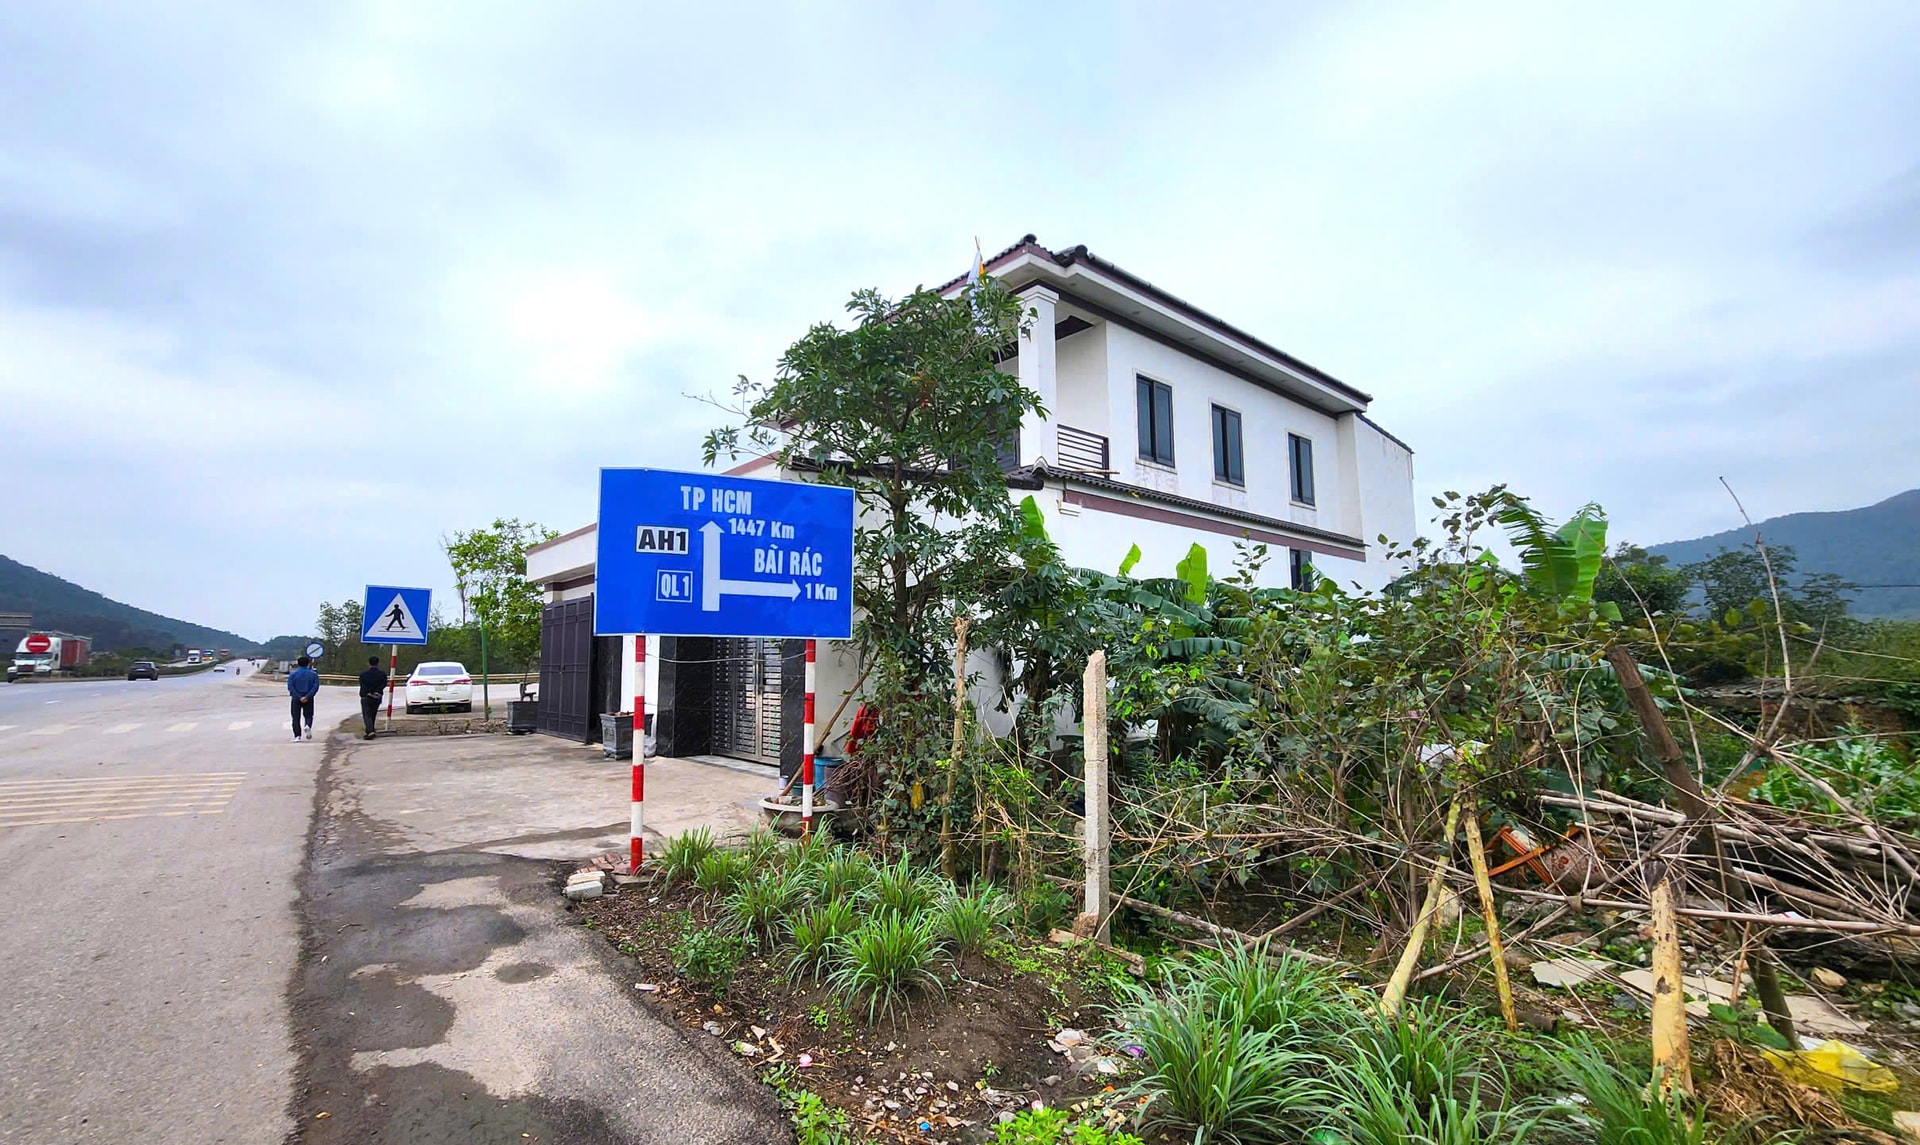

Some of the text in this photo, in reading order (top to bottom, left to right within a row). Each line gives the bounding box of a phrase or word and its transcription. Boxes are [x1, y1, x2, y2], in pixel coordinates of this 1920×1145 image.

[680, 486, 752, 515] TP HCM
[728, 517, 794, 539] 1447 Km
[638, 529, 687, 552] AH1
[754, 543, 823, 577] BÃI RÁC
[804, 582, 838, 601] 1 Km
